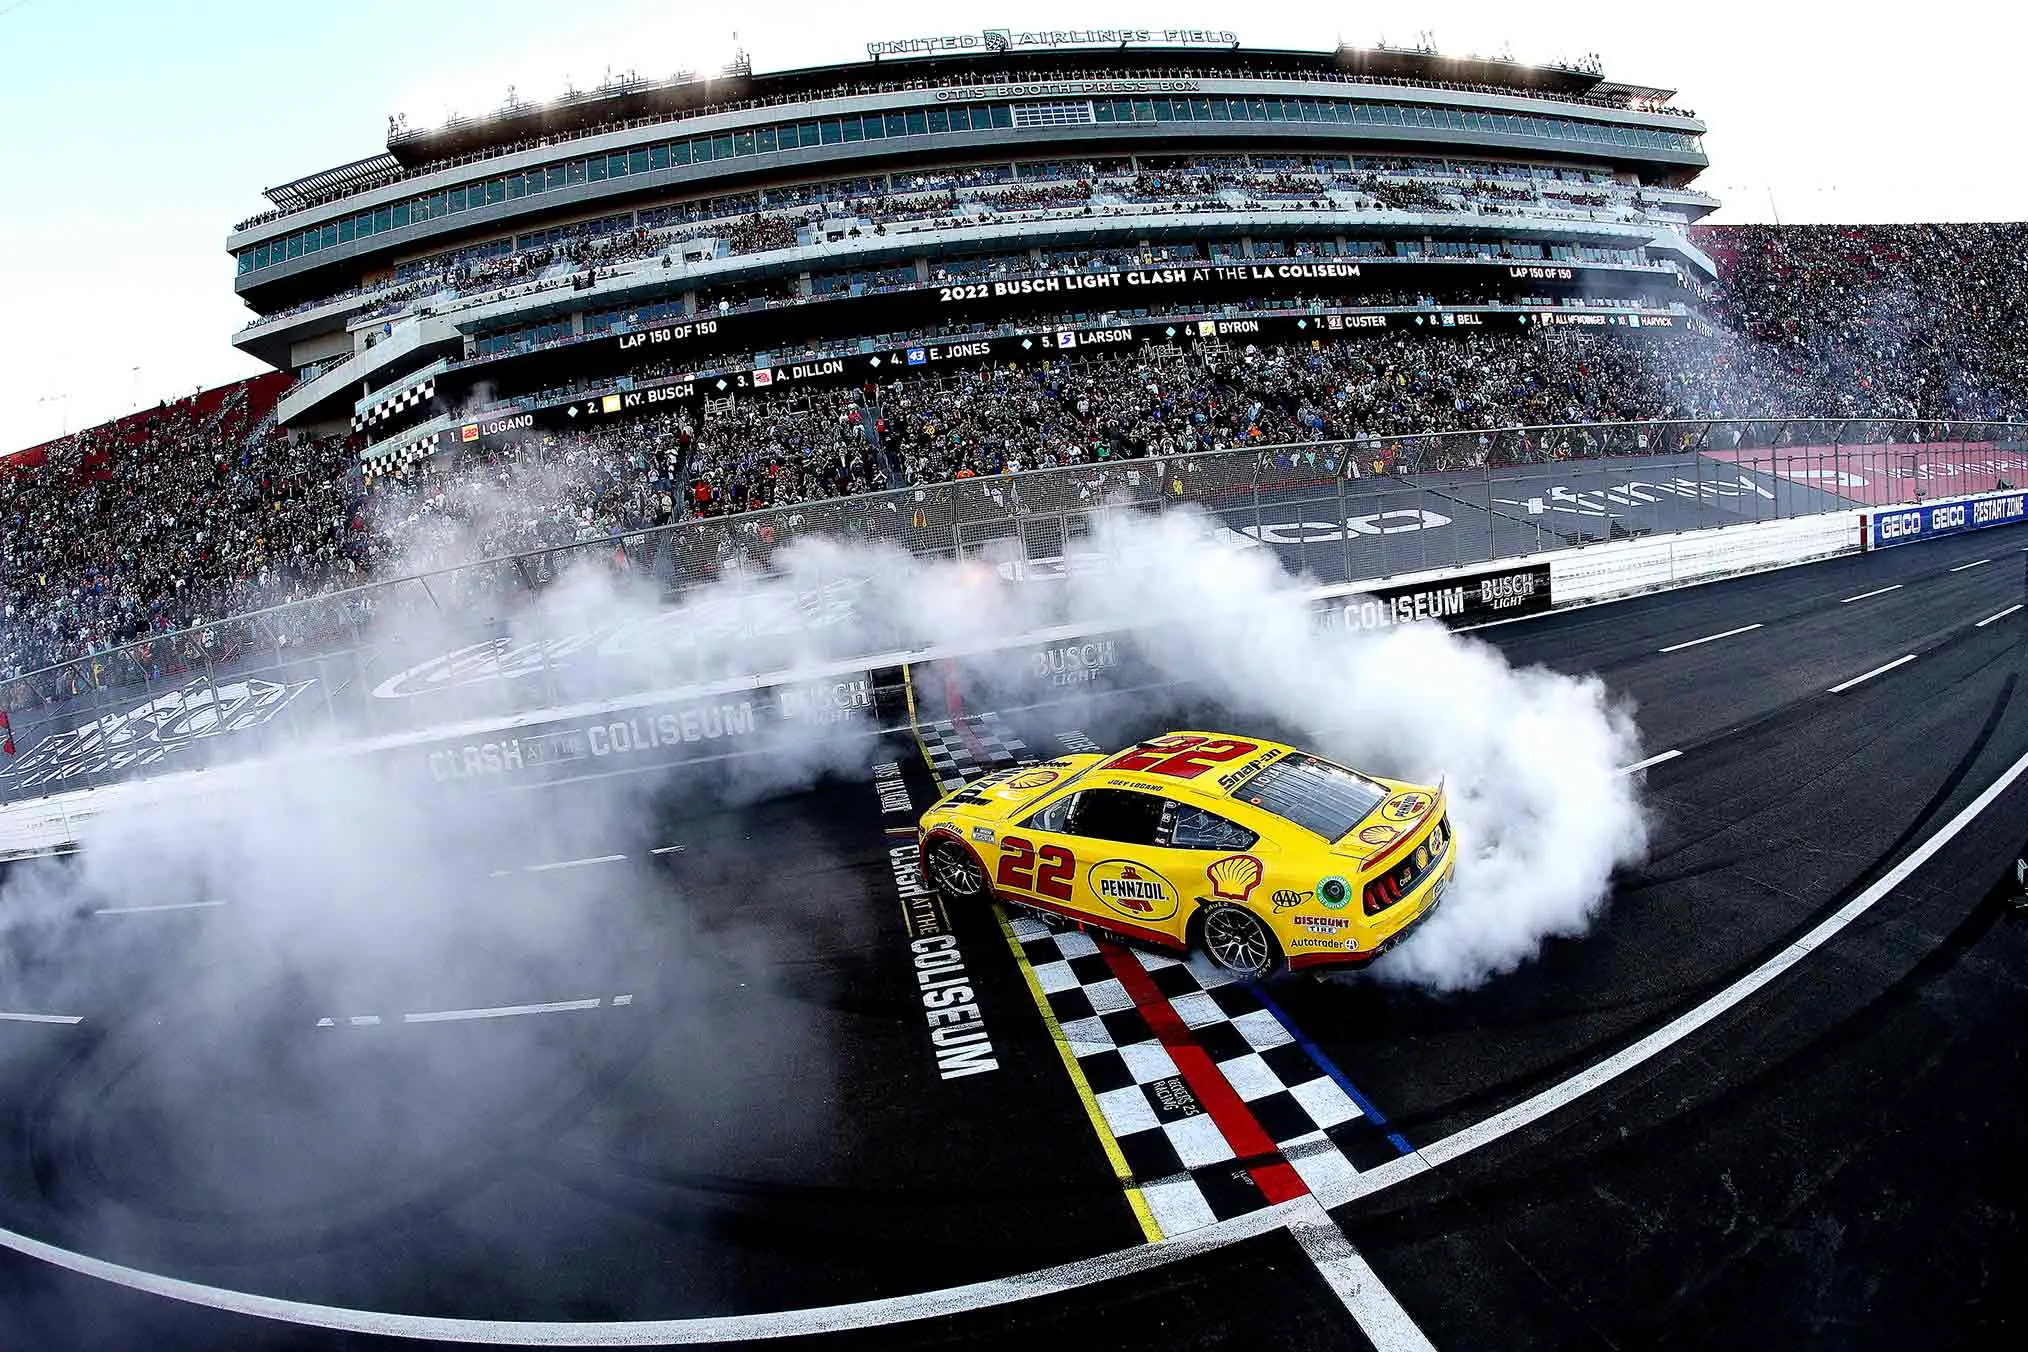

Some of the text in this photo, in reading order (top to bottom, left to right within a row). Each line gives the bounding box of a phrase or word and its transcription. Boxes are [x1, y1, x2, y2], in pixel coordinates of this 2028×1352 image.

[867, 29, 1238, 55] UNITED AIRLINES FIELD
[936, 79, 1200, 102] OTIS BOOTH PRESS BOX
[940, 263, 1361, 302] 2022 BUSCH LIGHT CLASH AT THE LA COLISEUM
[1510, 267, 1572, 279] LAP 150 OF 150
[1185, 325, 1196, 337] 6.
[1219, 321, 1259, 334] BYRON
[1314, 318, 1325, 329] 7.
[1345, 316, 1387, 328] CUSTER
[1430, 315, 1440, 325] 8.
[1457, 315, 1483, 325] BELL
[1641, 316, 1673, 327] HARVICK
[619, 320, 718, 350] LAP 150 OF 150
[1042, 329, 1132, 348] 5. 5 LARSON
[890, 342, 991, 365] 4. 43 E. JONES
[737, 376, 749, 388] 3.
[776, 369, 790, 382] A.
[793, 360, 844, 380] DILLON
[587, 402, 599, 415] 2.
[624, 393, 647, 408] KY.
[648, 383, 695, 403] BUSCH
[450, 431, 459, 443] 1.
[482, 415, 534, 437] LOGANO
[1881, 505, 1965, 539] GEICO GEICO
[1973, 495, 2024, 524] RESTART ZONE
[1481, 573, 1535, 603] BUSCH
[1344, 586, 1465, 632] COLISEUM
[1493, 596, 1523, 610] LIGHT
[779, 680, 872, 719] BCH
[429, 737, 525, 783] CLASH
[588, 701, 755, 757] COLISEUM
[1098, 736, 1258, 780] 22
[872, 762, 908, 789] BUSH
[1107, 779, 1164, 792] JOEY LOGANO
[997, 835, 1077, 902] 22
[1100, 879, 1168, 901] PENNZOIL
[1274, 890, 1300, 907] AAA
[1293, 915, 1350, 928] DISCOUNT
[1290, 938, 1344, 949] Autotrader
[910, 934, 1000, 1080] COLISEUM
[1153, 1081, 1179, 1111] RACING
[1182, 1105, 1200, 1116] 25
